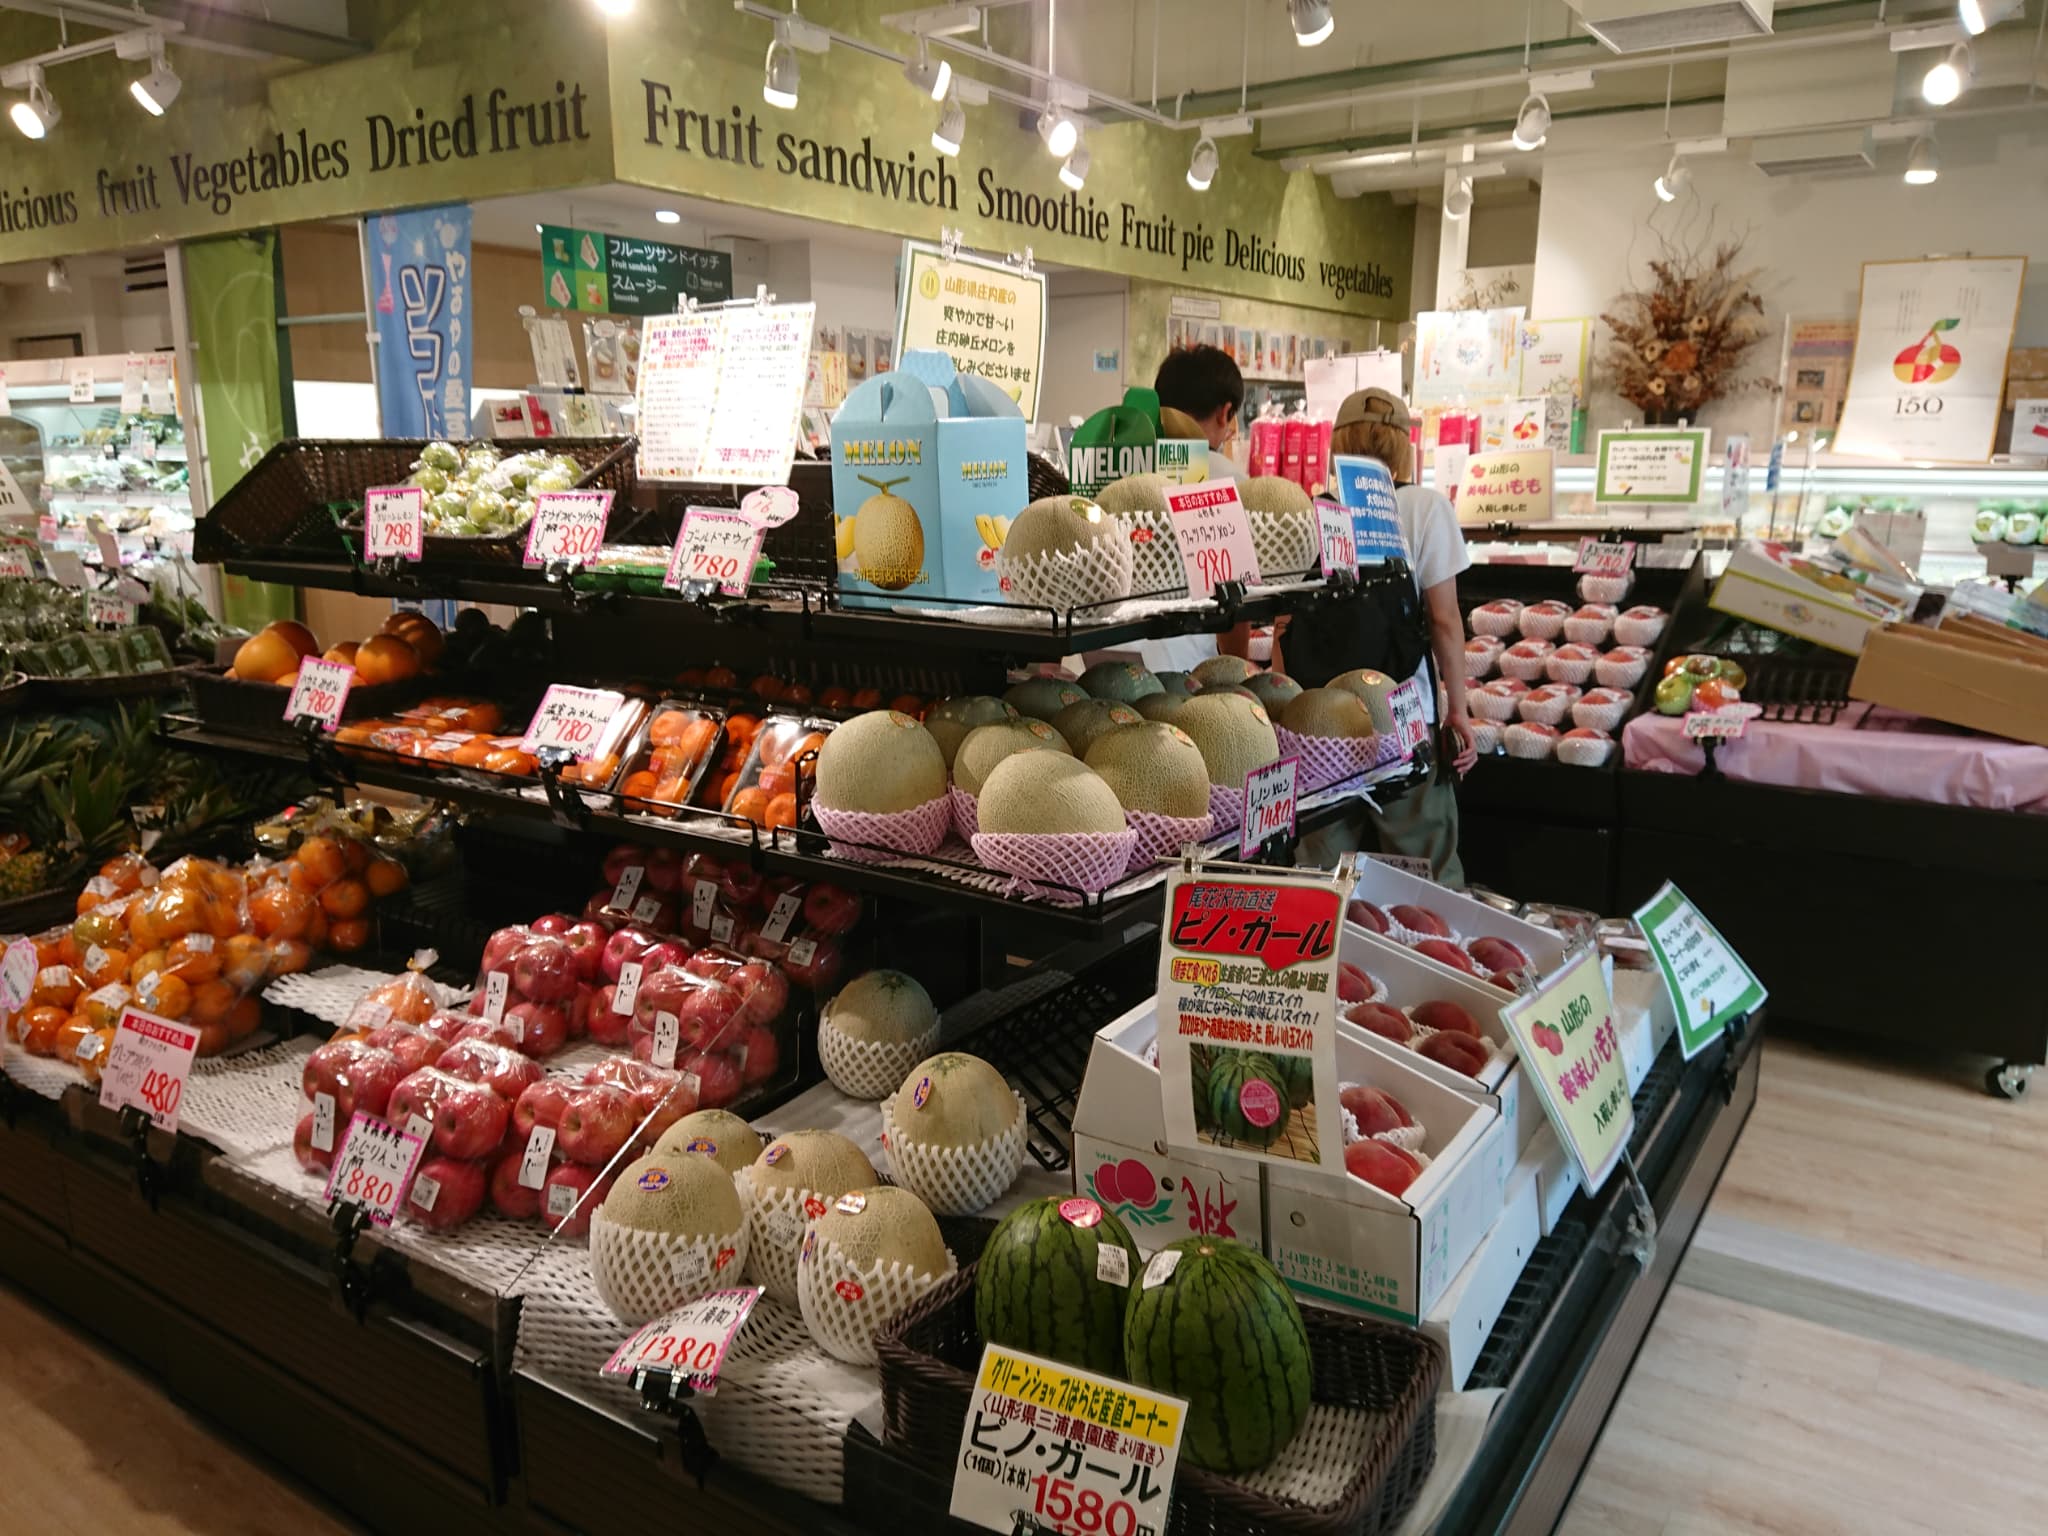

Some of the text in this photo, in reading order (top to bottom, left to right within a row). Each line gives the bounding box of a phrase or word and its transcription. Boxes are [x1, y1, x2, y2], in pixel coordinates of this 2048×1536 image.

[97, 165, 160, 217] fruit
[170, 128, 349, 215] Vegetables
[365, 93, 478, 173] Dried
[485, 81, 591, 153] fruit
[641, 78, 1394, 300] Fruit sandwich Smoothie Fruit pie Delicious vegetables
[609, 239, 720, 269] フルーツサンドイッチ
[612, 274, 667, 292] スムージー
[944, 276, 1017, 305] 山形県庄内産の
[936, 328, 1016, 356] 庄内砂丘メロンを
[952, 355, 1031, 383] しみくださいませ
[1896, 396, 1944, 415] 150
[843, 439, 922, 466] MELON
[1072, 446, 1154, 484] MELON
[1159, 443, 1189, 466] MELON
[961, 461, 1007, 481] MELON
[1178, 489, 1230, 510] 本日のおすすめ品
[385, 523, 412, 547] 298
[552, 524, 598, 556] 380
[686, 529, 752, 550] ゴールドキウイ
[694, 554, 738, 579] 780
[1197, 548, 1232, 591] 980
[306, 687, 335, 715] 980
[556, 718, 592, 742] 780
[1257, 799, 1292, 834] 1480
[1189, 886, 1277, 911] 尾花沢市直送
[1173, 911, 1332, 956] ピノ・ガール
[1174, 960, 1218, 982] 種まで食べれる
[1193, 985, 1303, 1008] マイクロシードの小玉スイカ
[1560, 993, 1593, 1036] 山形の
[131, 1017, 186, 1047] 本日のおすすめ品
[1558, 1015, 1618, 1105] 美味しいもも
[141, 1068, 181, 1114] 480
[348, 1136, 407, 1170] ふじりんご
[347, 1168, 393, 1206] 880
[637, 1335, 717, 1371] 1380
[970, 1410, 1162, 1504] ピノ・ガール
[1031, 1473, 1137, 1532] 1580
